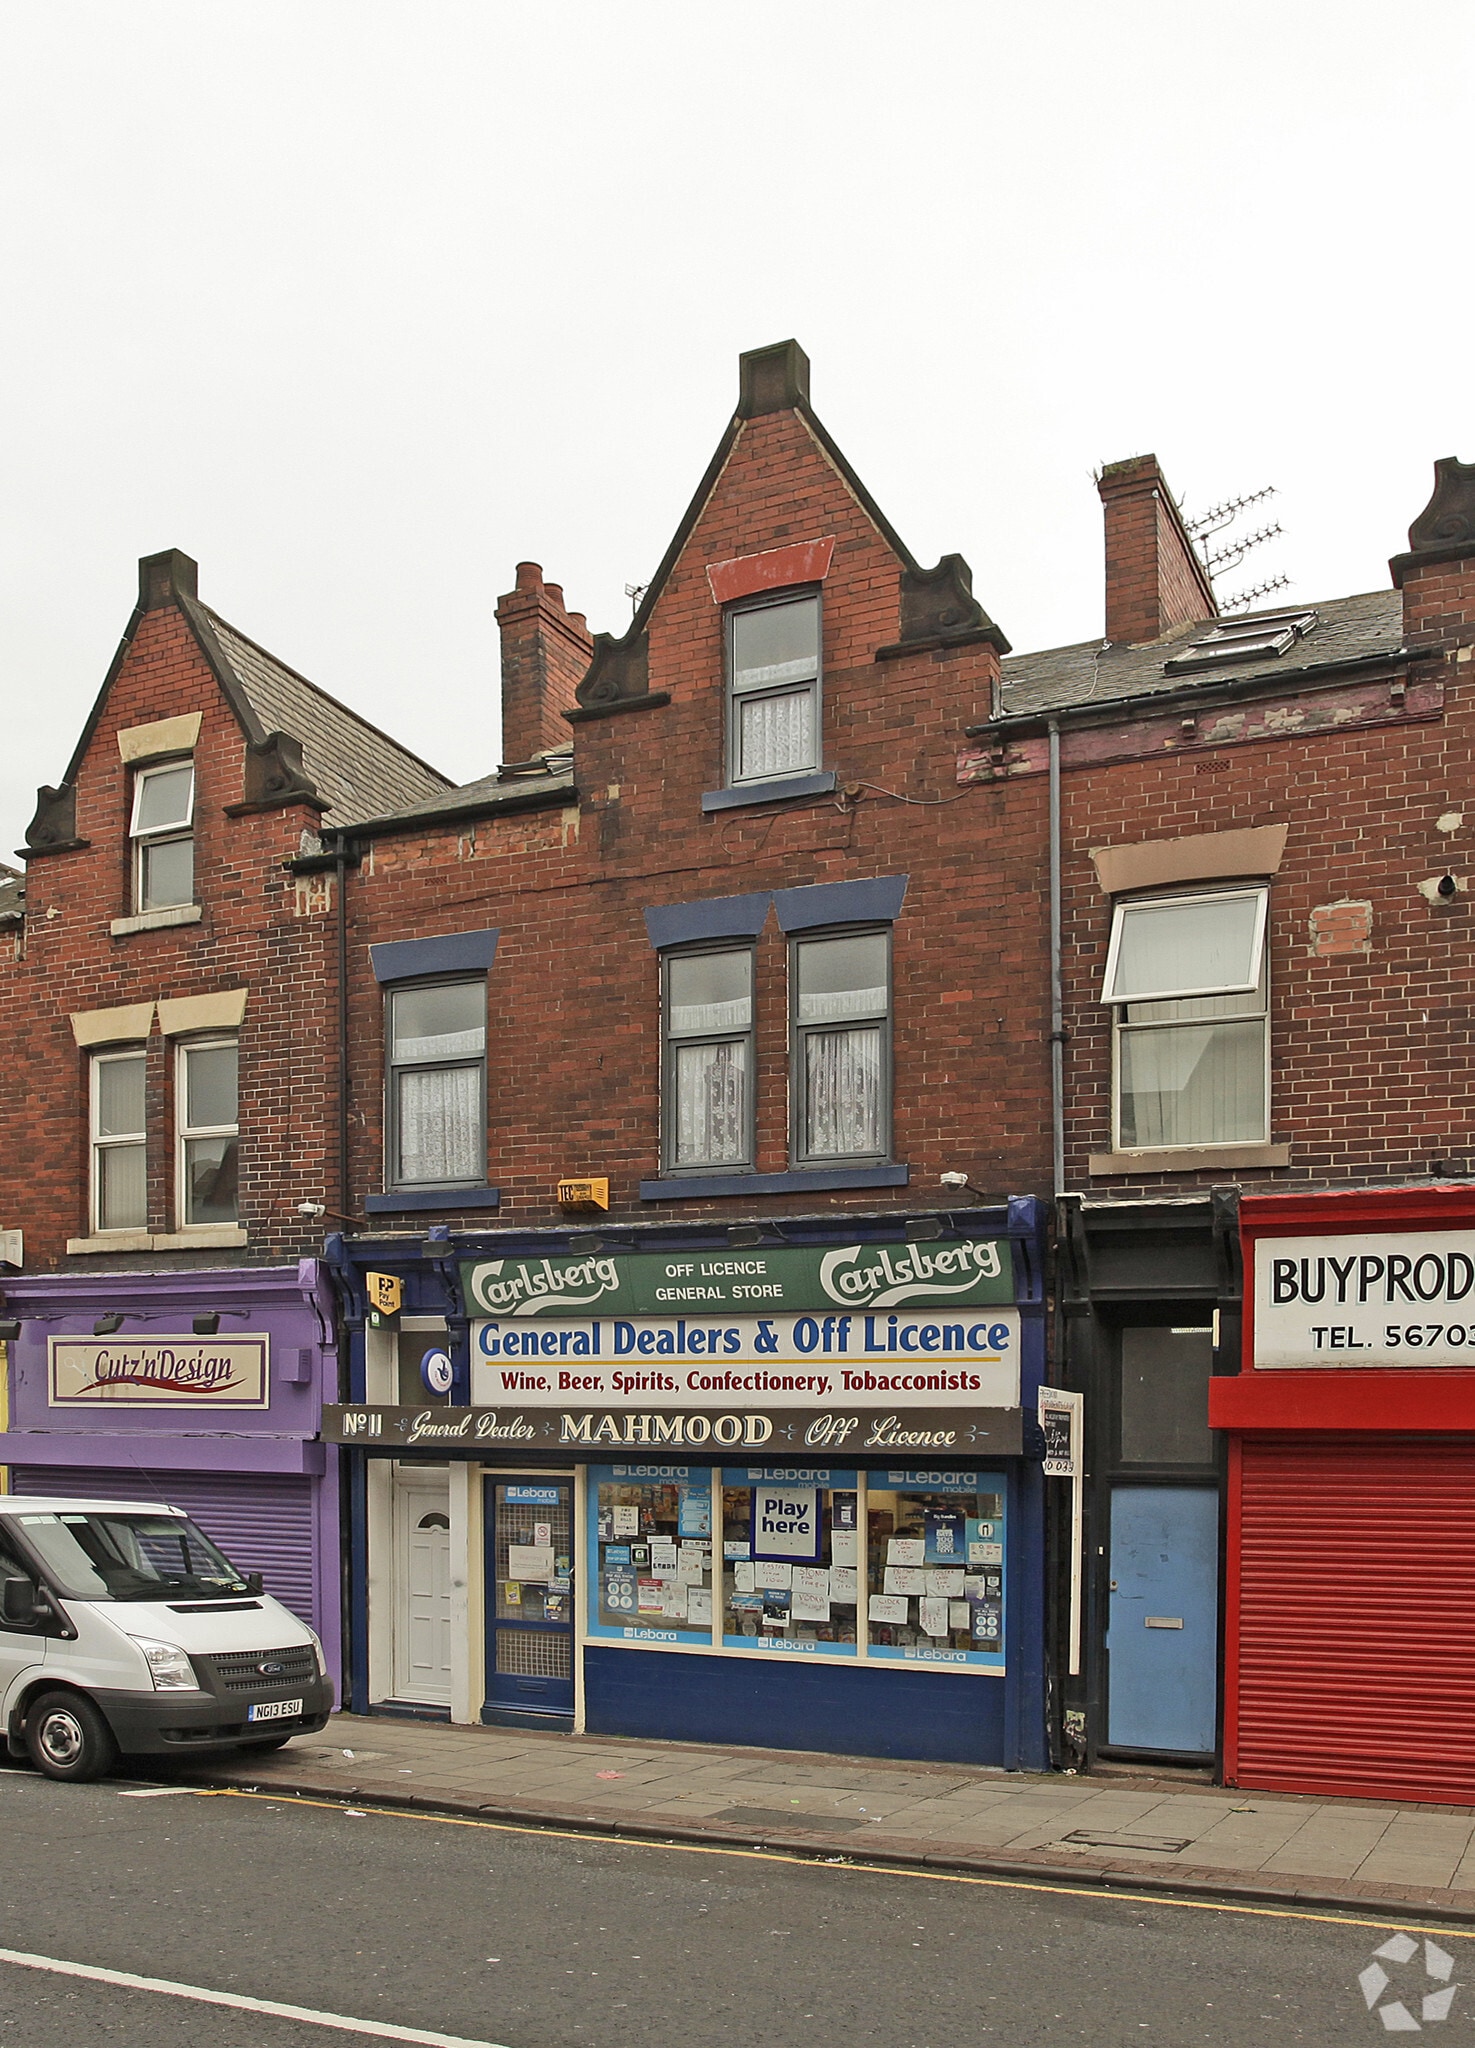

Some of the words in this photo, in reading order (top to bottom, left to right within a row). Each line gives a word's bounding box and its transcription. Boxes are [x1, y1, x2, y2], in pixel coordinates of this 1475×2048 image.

[665, 1264, 694, 1278] OFF
[700, 1261, 767, 1276] LICENCE
[820, 1240, 1001, 1307] Carlsberg
[471, 1256, 620, 1315] Carlsberg
[655, 1287, 726, 1301] GENERAL
[732, 1284, 784, 1299] STORE
[478, 1321, 601, 1356] General
[613, 1319, 742, 1355] Dealers
[753, 1320, 779, 1354] &
[792, 1316, 852, 1354] Off
[864, 1315, 1010, 1352] Licence
[1311, 1326, 1373, 1349] TEL.
[500, 1371, 552, 1393] Wine,
[558, 1371, 605, 1393] Beer,
[611, 1371, 680, 1395] Spirits,
[686, 1370, 833, 1396] Confectionery,
[840, 1369, 981, 1391] Tobacconists
[407, 1410, 472, 1443] General
[475, 1412, 536, 1441] Dealer
[559, 1414, 773, 1446] MAHMOOD
[804, 1414, 859, 1446] Off
[863, 1415, 957, 1447] Licence
[628, 1465, 689, 1477] Lebara
[763, 1468, 830, 1480] Lebara
[905, 1471, 977, 1485] Lebara
[516, 1487, 557, 1498] Lebara
[798, 1481, 829, 1489] mobile
[942, 1485, 977, 1494] mobile
[765, 1499, 809, 1519] Play
[762, 1517, 810, 1534] here
[634, 1628, 677, 1640] Lebara
[769, 1638, 815, 1651] Lebara
[916, 1648, 967, 1661] Lebara
[256, 1704, 279, 1718] NG13
[281, 1701, 300, 1714] ESU
